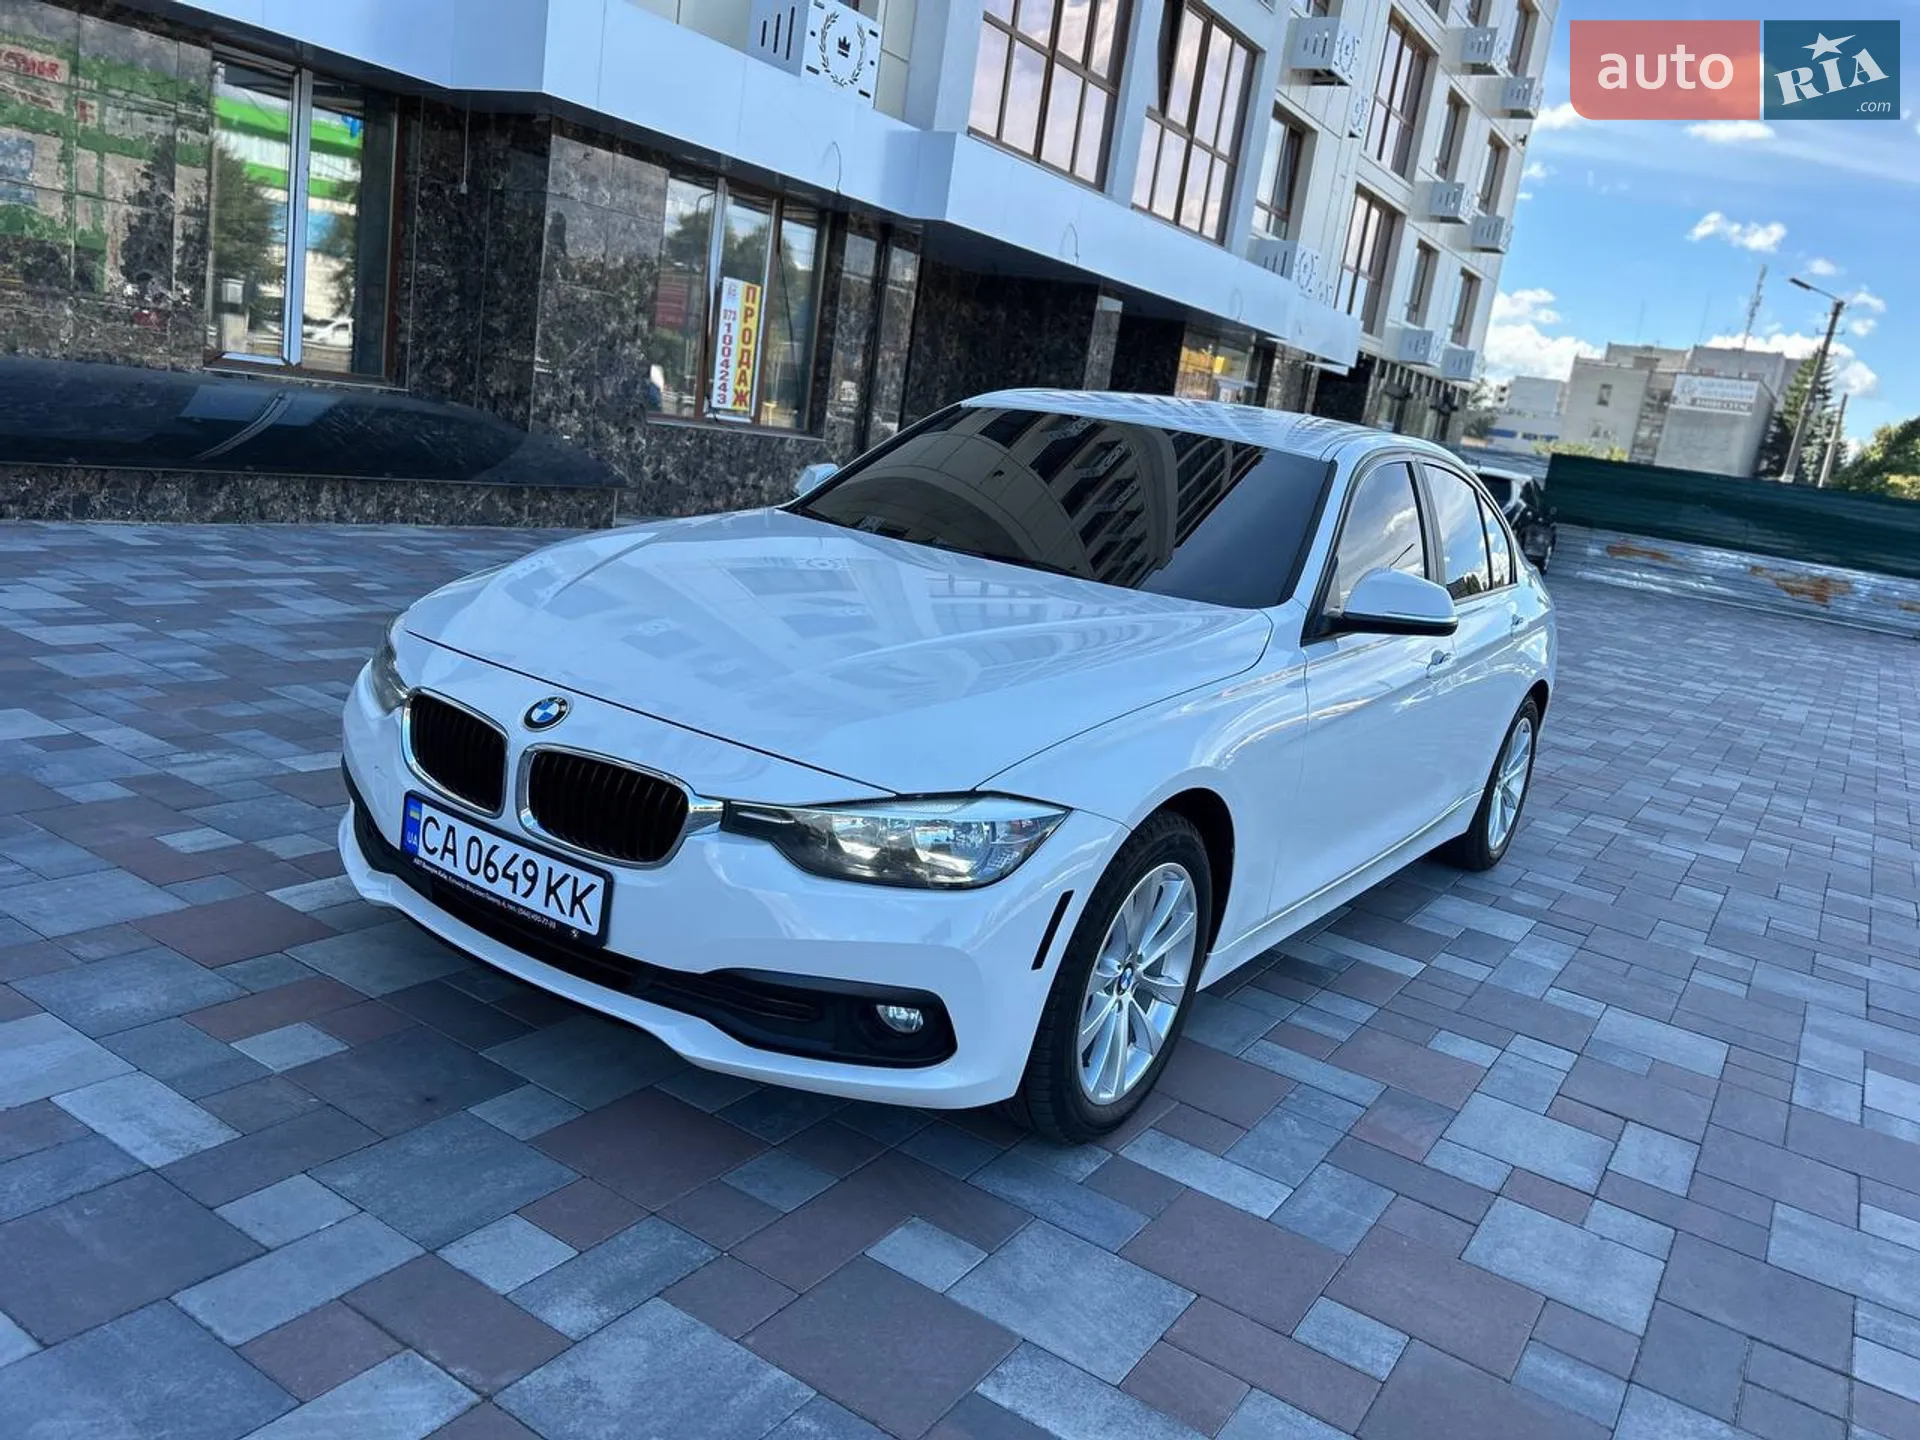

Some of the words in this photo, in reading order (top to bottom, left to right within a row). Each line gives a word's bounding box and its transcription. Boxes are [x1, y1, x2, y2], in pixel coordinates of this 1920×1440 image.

[717, 322, 733, 405] 1004243
[732, 285, 757, 407] ПРОДАЖ
[407, 830, 418, 848] UA
[422, 816, 458, 868] CA
[466, 835, 539, 899] 0649
[545, 866, 597, 926] KK
